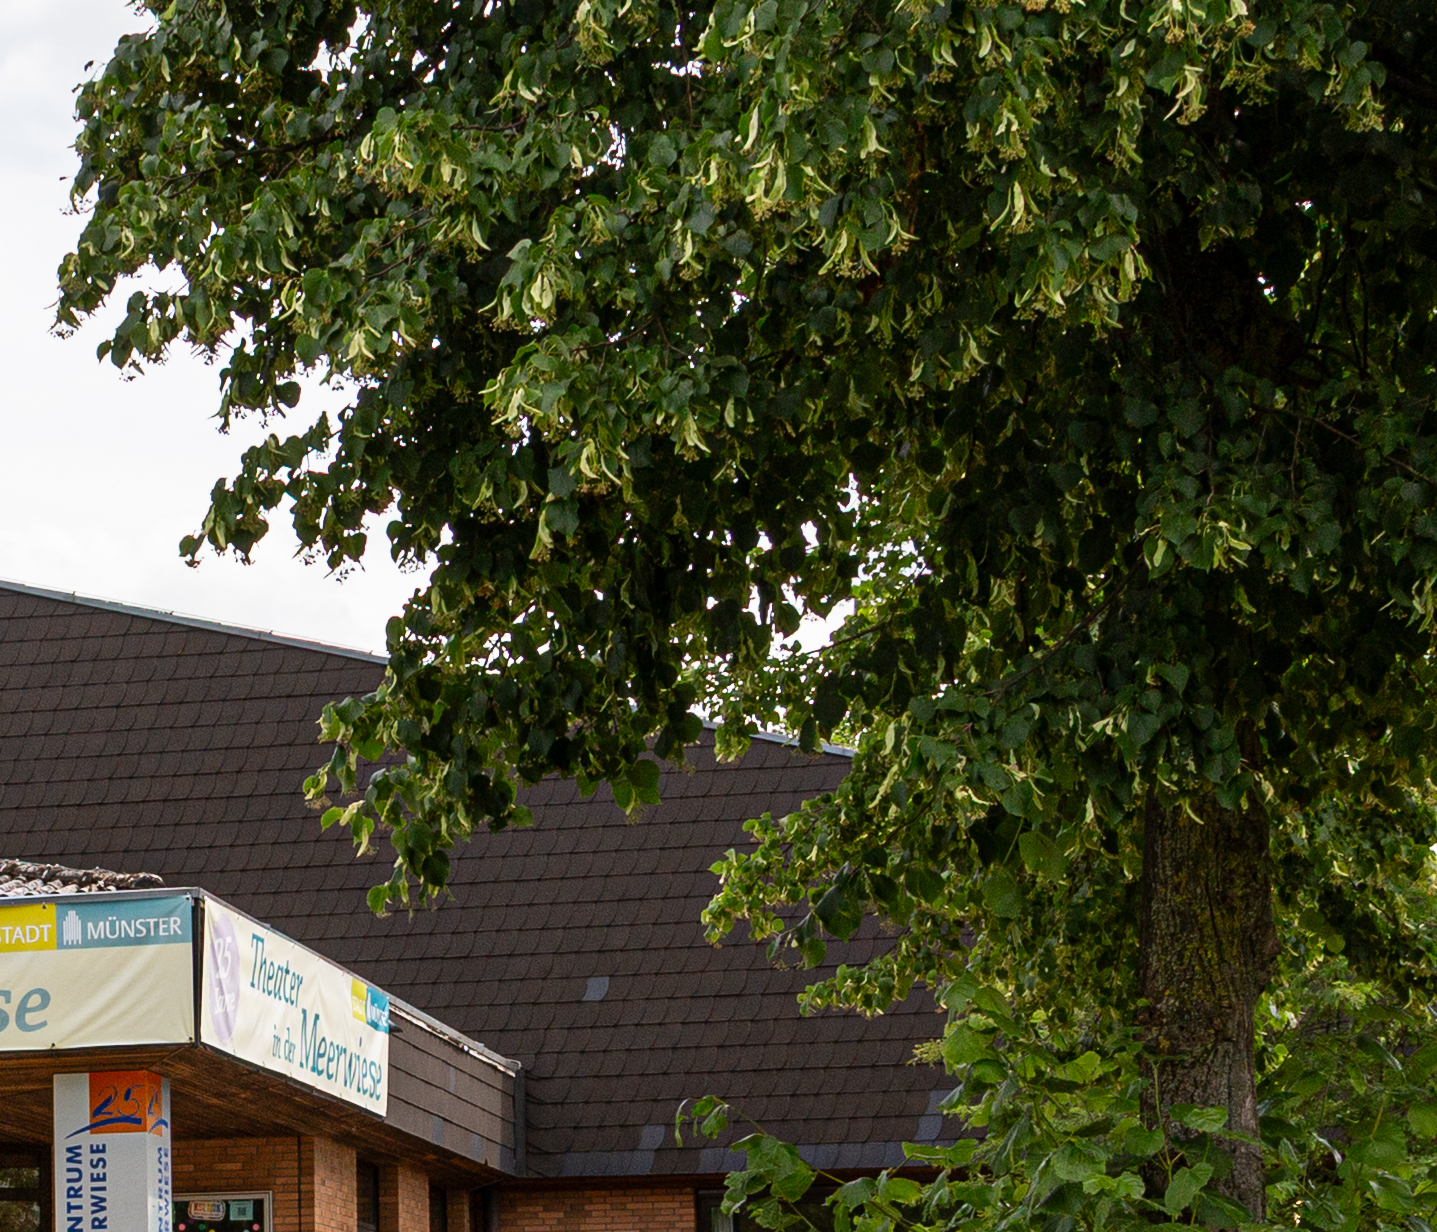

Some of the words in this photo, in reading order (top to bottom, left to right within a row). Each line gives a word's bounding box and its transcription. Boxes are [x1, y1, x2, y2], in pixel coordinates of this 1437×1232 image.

[86, 916, 183, 940] MÜNSTER
[250, 933, 304, 1009] Theater
[272, 1025, 281, 1060] in
[283, 1027, 297, 1065] der
[299, 1008, 382, 1101] Meerwiese
[92, 1085, 145, 1119] 25
